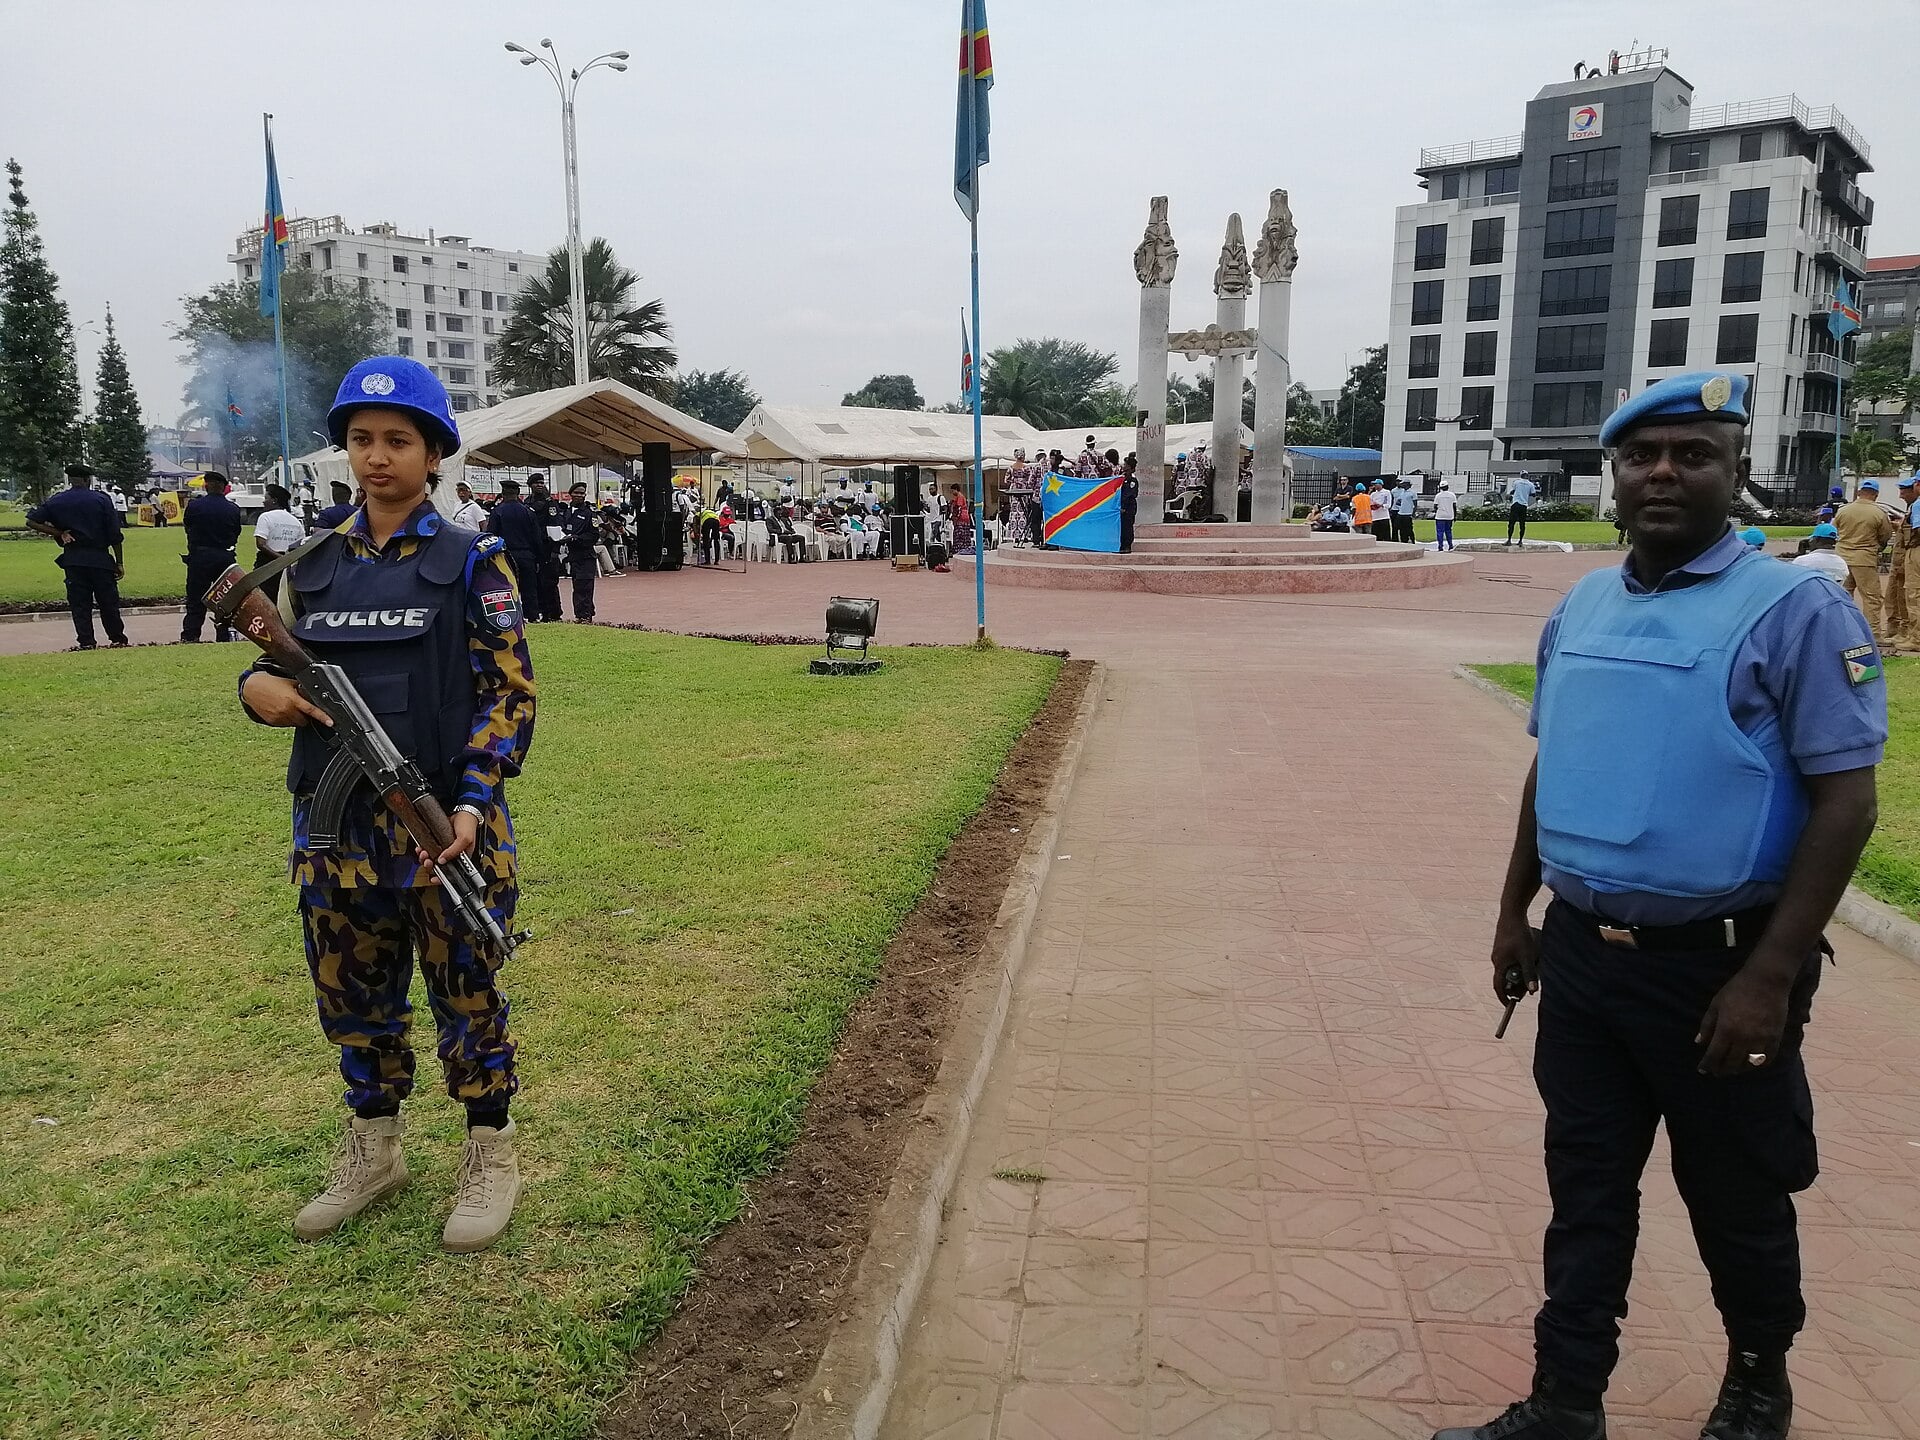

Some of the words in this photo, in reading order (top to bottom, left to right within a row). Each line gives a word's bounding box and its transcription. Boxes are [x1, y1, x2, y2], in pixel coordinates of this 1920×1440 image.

[1570, 131, 1600, 139] TOTAL
[752, 413, 764, 426] UN
[248, 616, 265, 635] 32
[304, 608, 429, 630] POLICE
